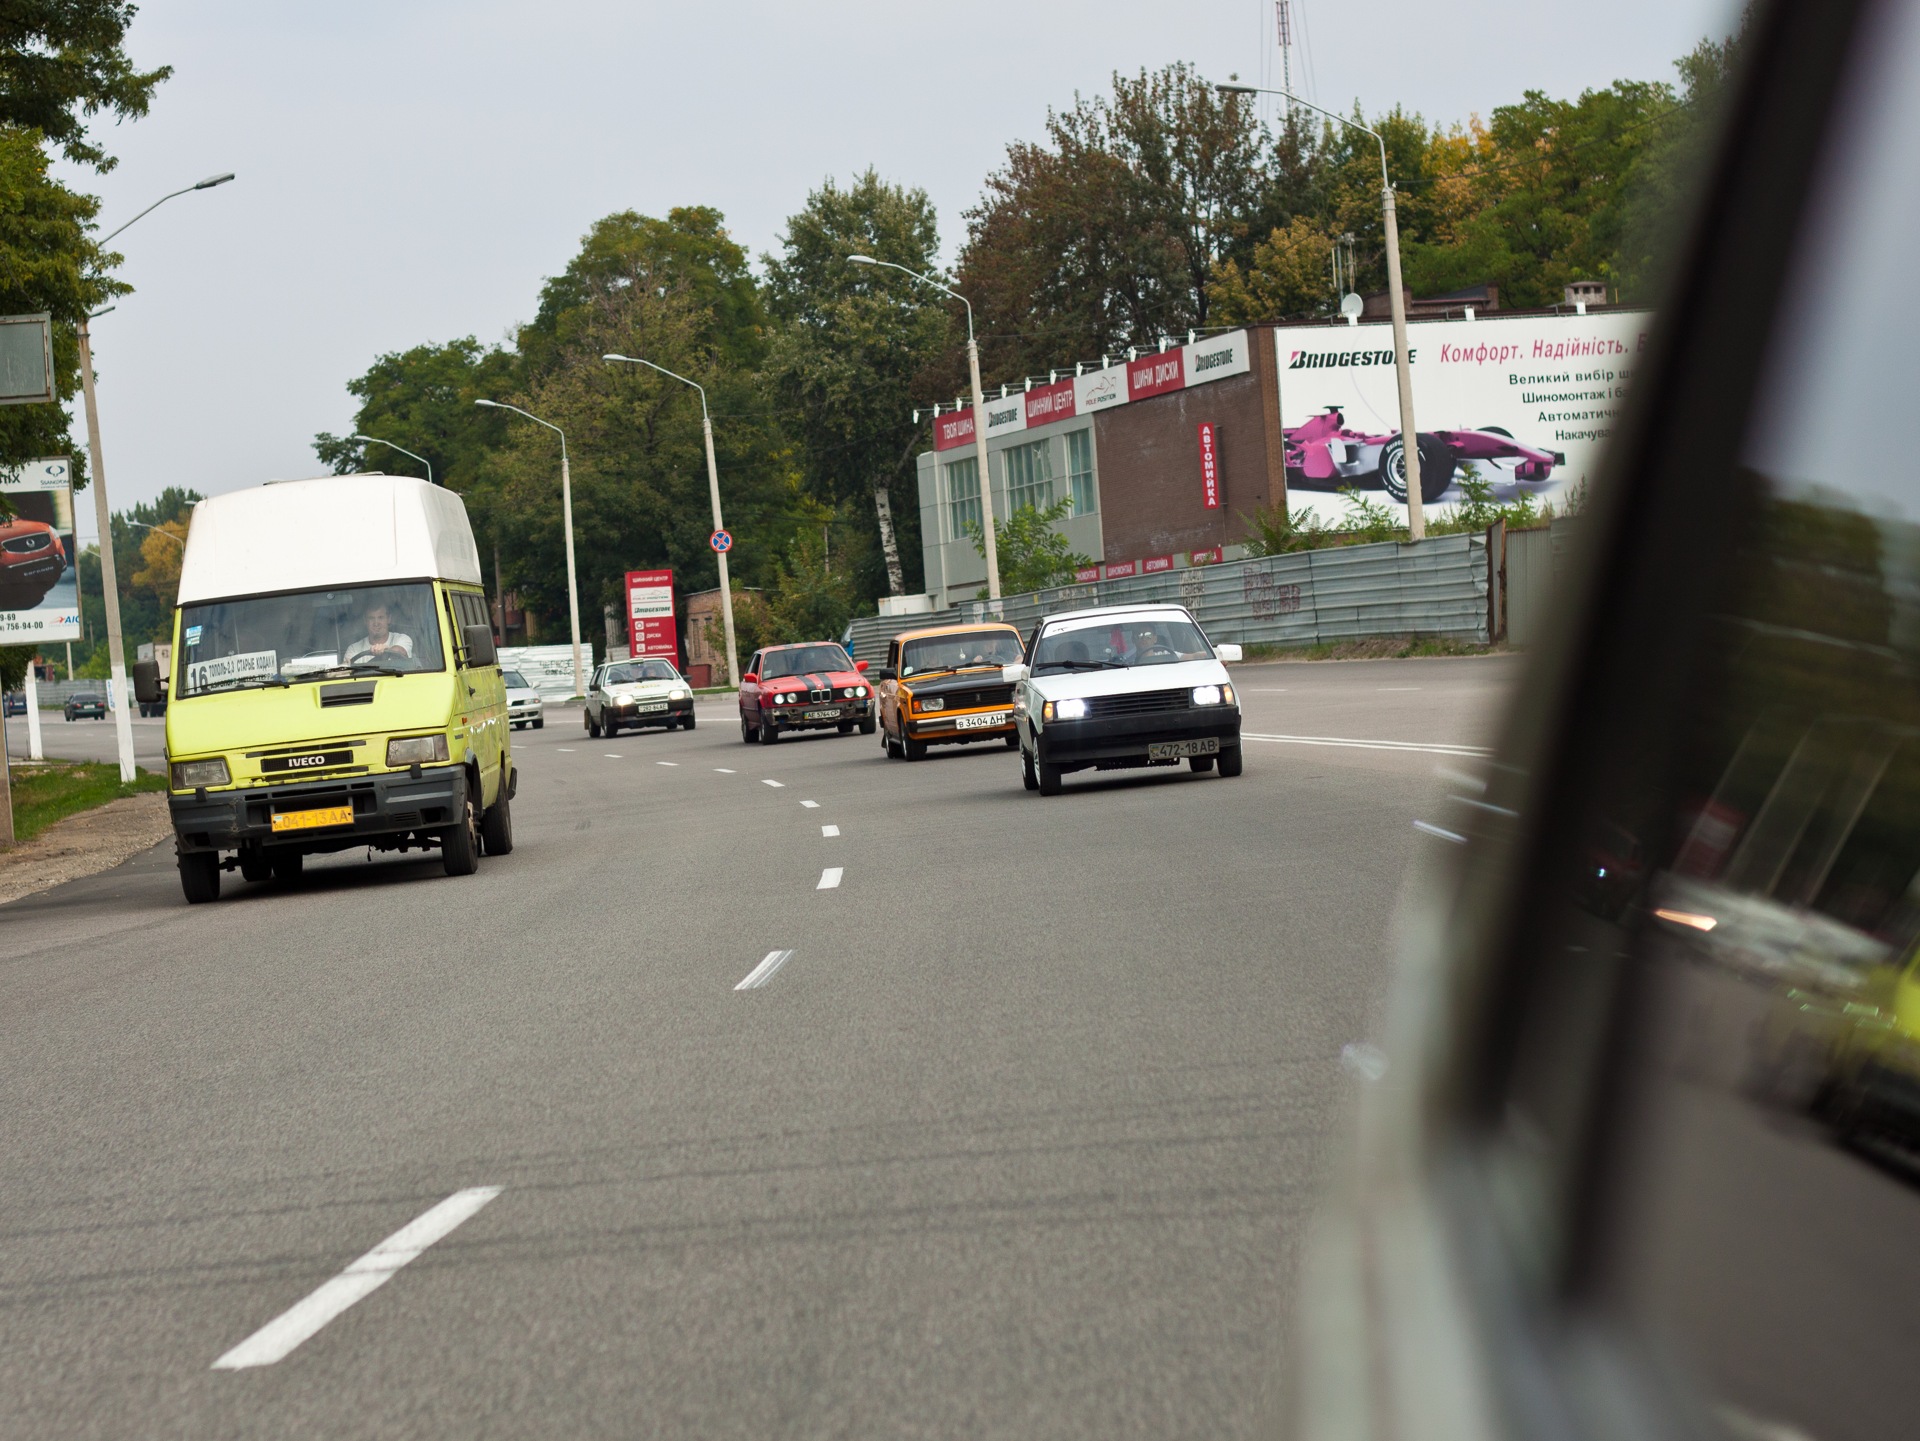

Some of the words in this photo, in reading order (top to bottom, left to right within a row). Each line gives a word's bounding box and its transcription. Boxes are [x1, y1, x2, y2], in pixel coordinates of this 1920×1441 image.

[1195, 349, 1233, 372] BRIDGESTONE
[1288, 349, 1417, 369] BRIDGESTOE
[1440, 342, 1523, 365] Комфорт.
[1532, 336, 1629, 360] Надійність.
[1133, 367, 1154, 389] ШИНИ
[1155, 361, 1179, 387] ДИСКИ
[1509, 371, 1570, 385] Великий
[1575, 369, 1614, 382] вибір
[1027, 392, 1053, 418] ШИННИЙ
[1053, 390, 1073, 413] ЦЕНТР
[1522, 388, 1605, 403] Шиномонтаж
[943, 422, 957, 440] ТВОЯ
[958, 418, 975, 436] ШИНА
[1202, 426, 1216, 506] АВТОМИЙКА
[6, 621, 43, 630] 756-94-00
[191, 666, 208, 693] 16
[966, 717, 988, 727] 3404
[288, 755, 325, 767] IVECO
